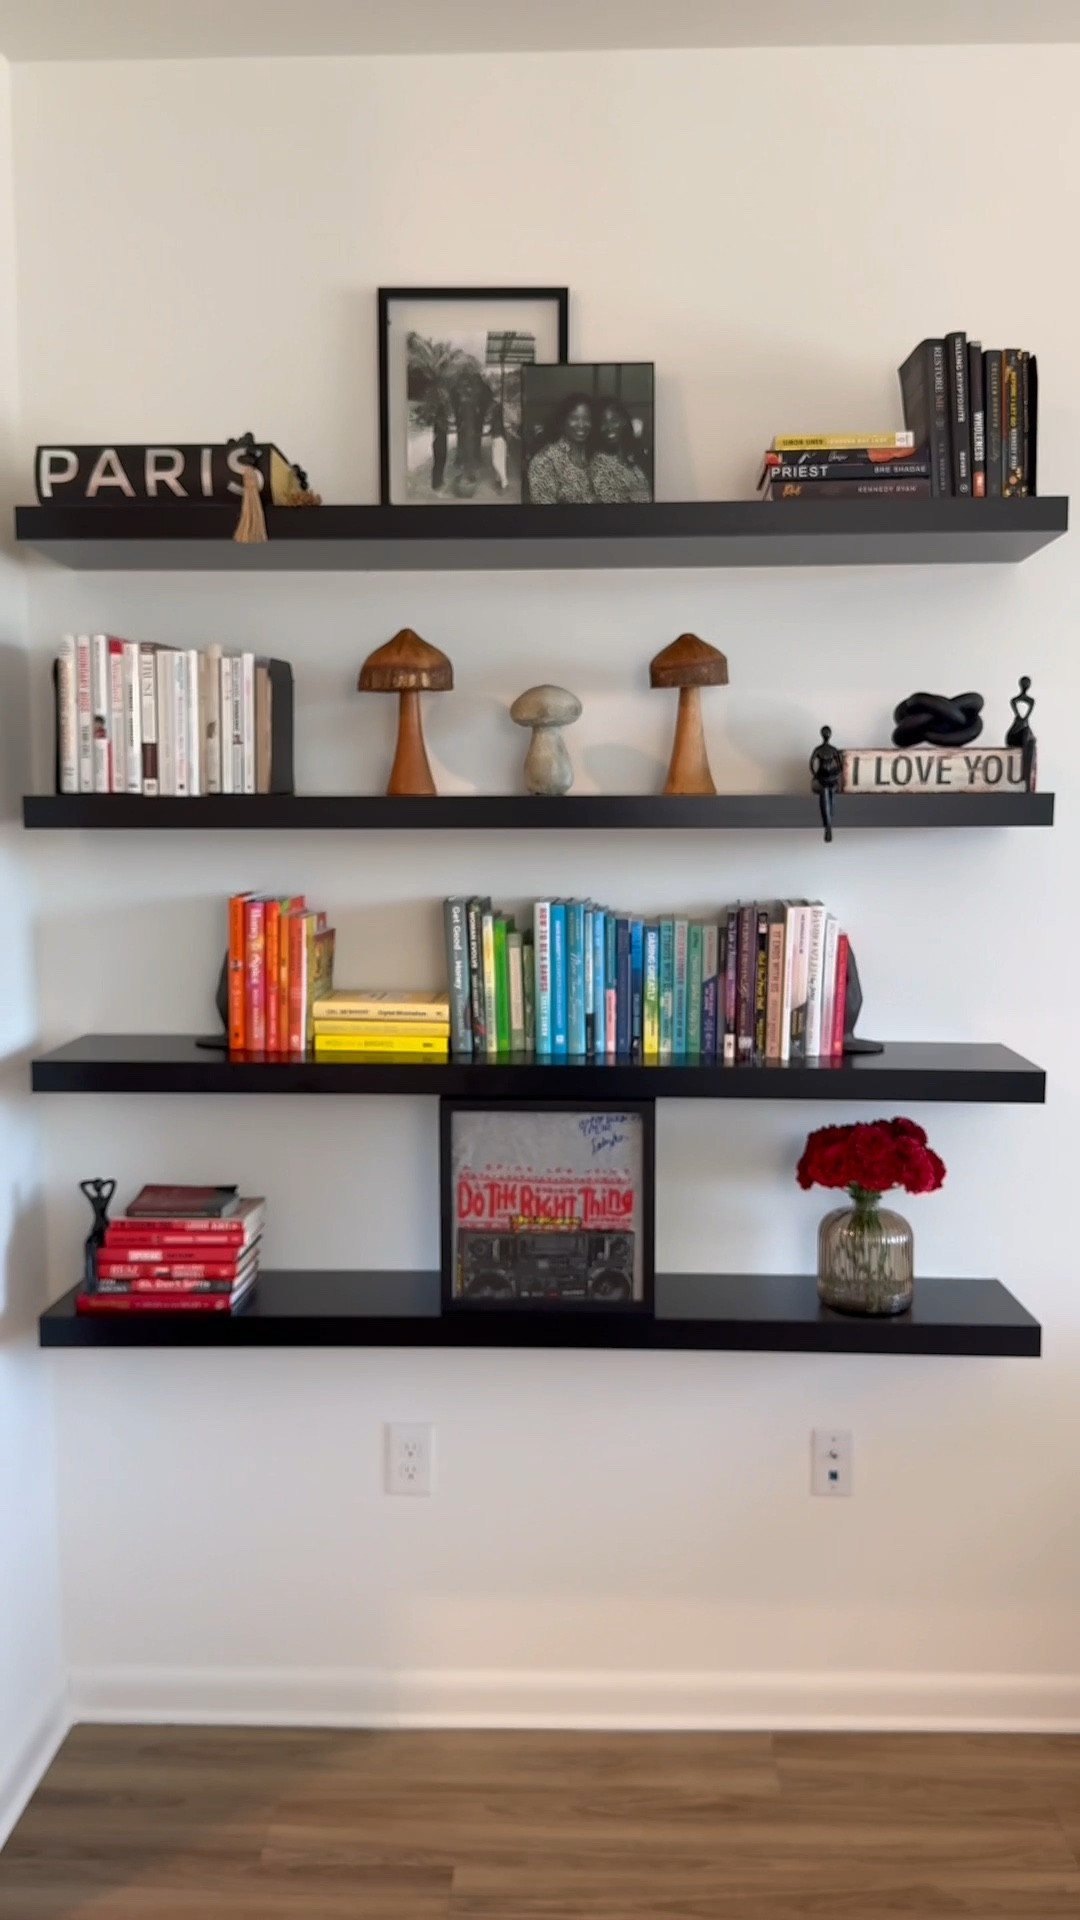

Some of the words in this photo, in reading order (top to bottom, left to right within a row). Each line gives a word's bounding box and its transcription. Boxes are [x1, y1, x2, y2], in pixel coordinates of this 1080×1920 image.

[954, 338, 964, 371] KILLING
[933, 347, 944, 394] RESTORE
[955, 372, 966, 423] KRYPTONITE
[973, 411, 985, 462] WHOLENESS
[40, 447, 264, 498] PARIS
[771, 465, 829, 478] PRIEST
[851, 756, 860, 786] I
[875, 755, 952, 786] LOVE
[963, 755, 1025, 785] YOU
[249, 909, 262, 940] Honey
[452, 906, 462, 924] Get
[469, 911, 477, 940] WOMAN
[539, 907, 548, 928] HOW
[453, 925, 463, 951] Good
[540, 930, 548, 941] TO
[540, 943, 548, 953] BE
[647, 932, 657, 964] DARING
[249, 953, 262, 985] Spice
[453, 960, 463, 990] Money
[647, 965, 657, 1002] GREATLY
[457, 1181, 485, 1218] Do
